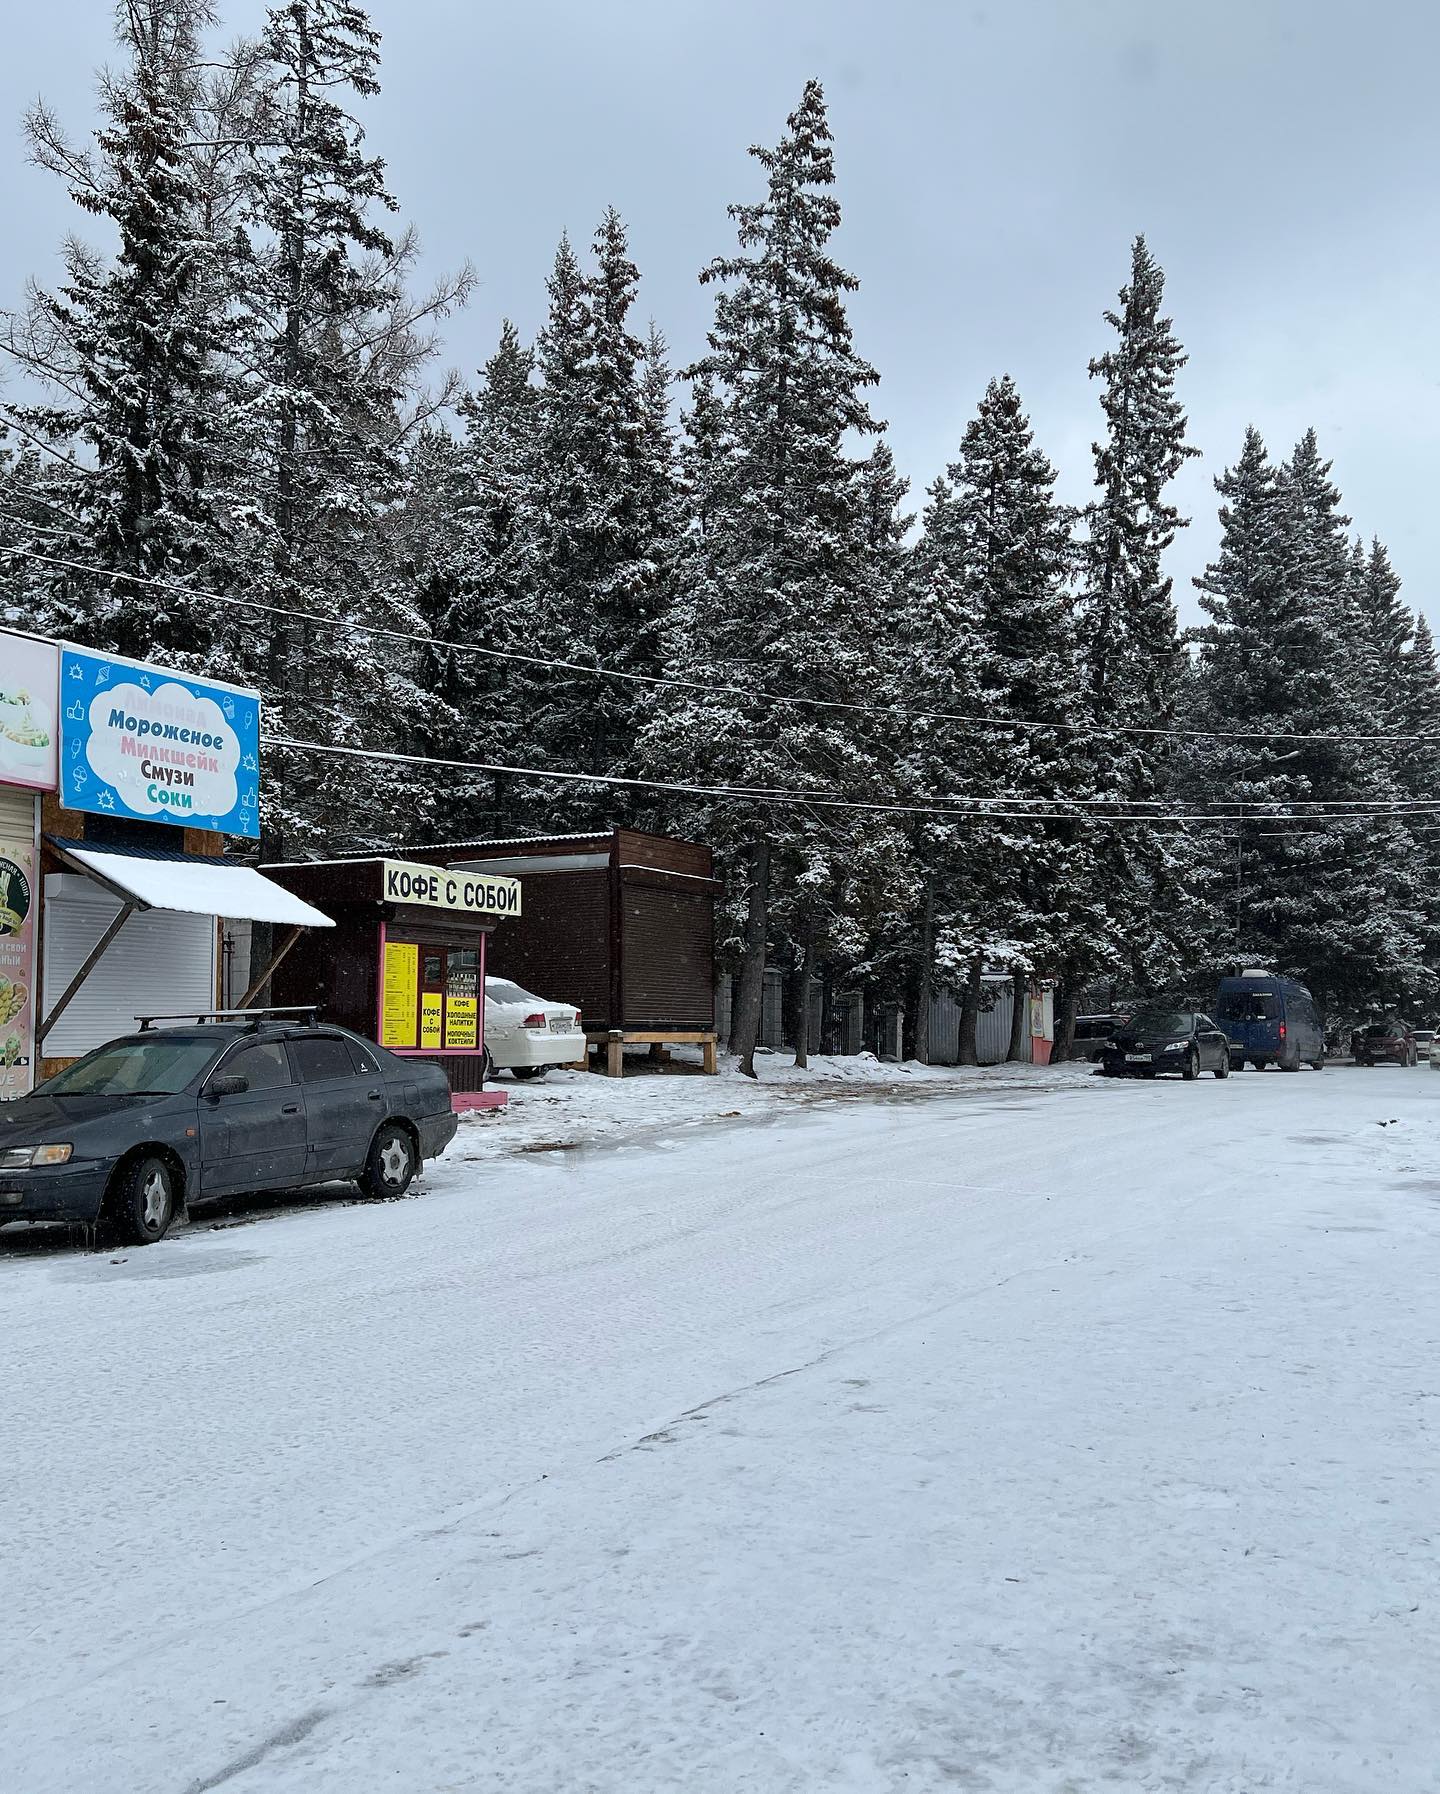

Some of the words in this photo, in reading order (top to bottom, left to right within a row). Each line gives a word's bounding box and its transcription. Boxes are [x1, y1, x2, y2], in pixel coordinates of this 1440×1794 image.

[108, 709, 224, 750] Мороженое
[120, 736, 219, 773] Милкшейк
[140, 760, 194, 786] Смузи
[147, 784, 193, 808] Соки
[388, 870, 439, 901] КОФЕ
[446, 880, 457, 904] С
[464, 881, 518, 911] СОБОЙ
[423, 1008, 440, 1017] КОФЕ
[423, 1025, 440, 1034] СОБОЙ
